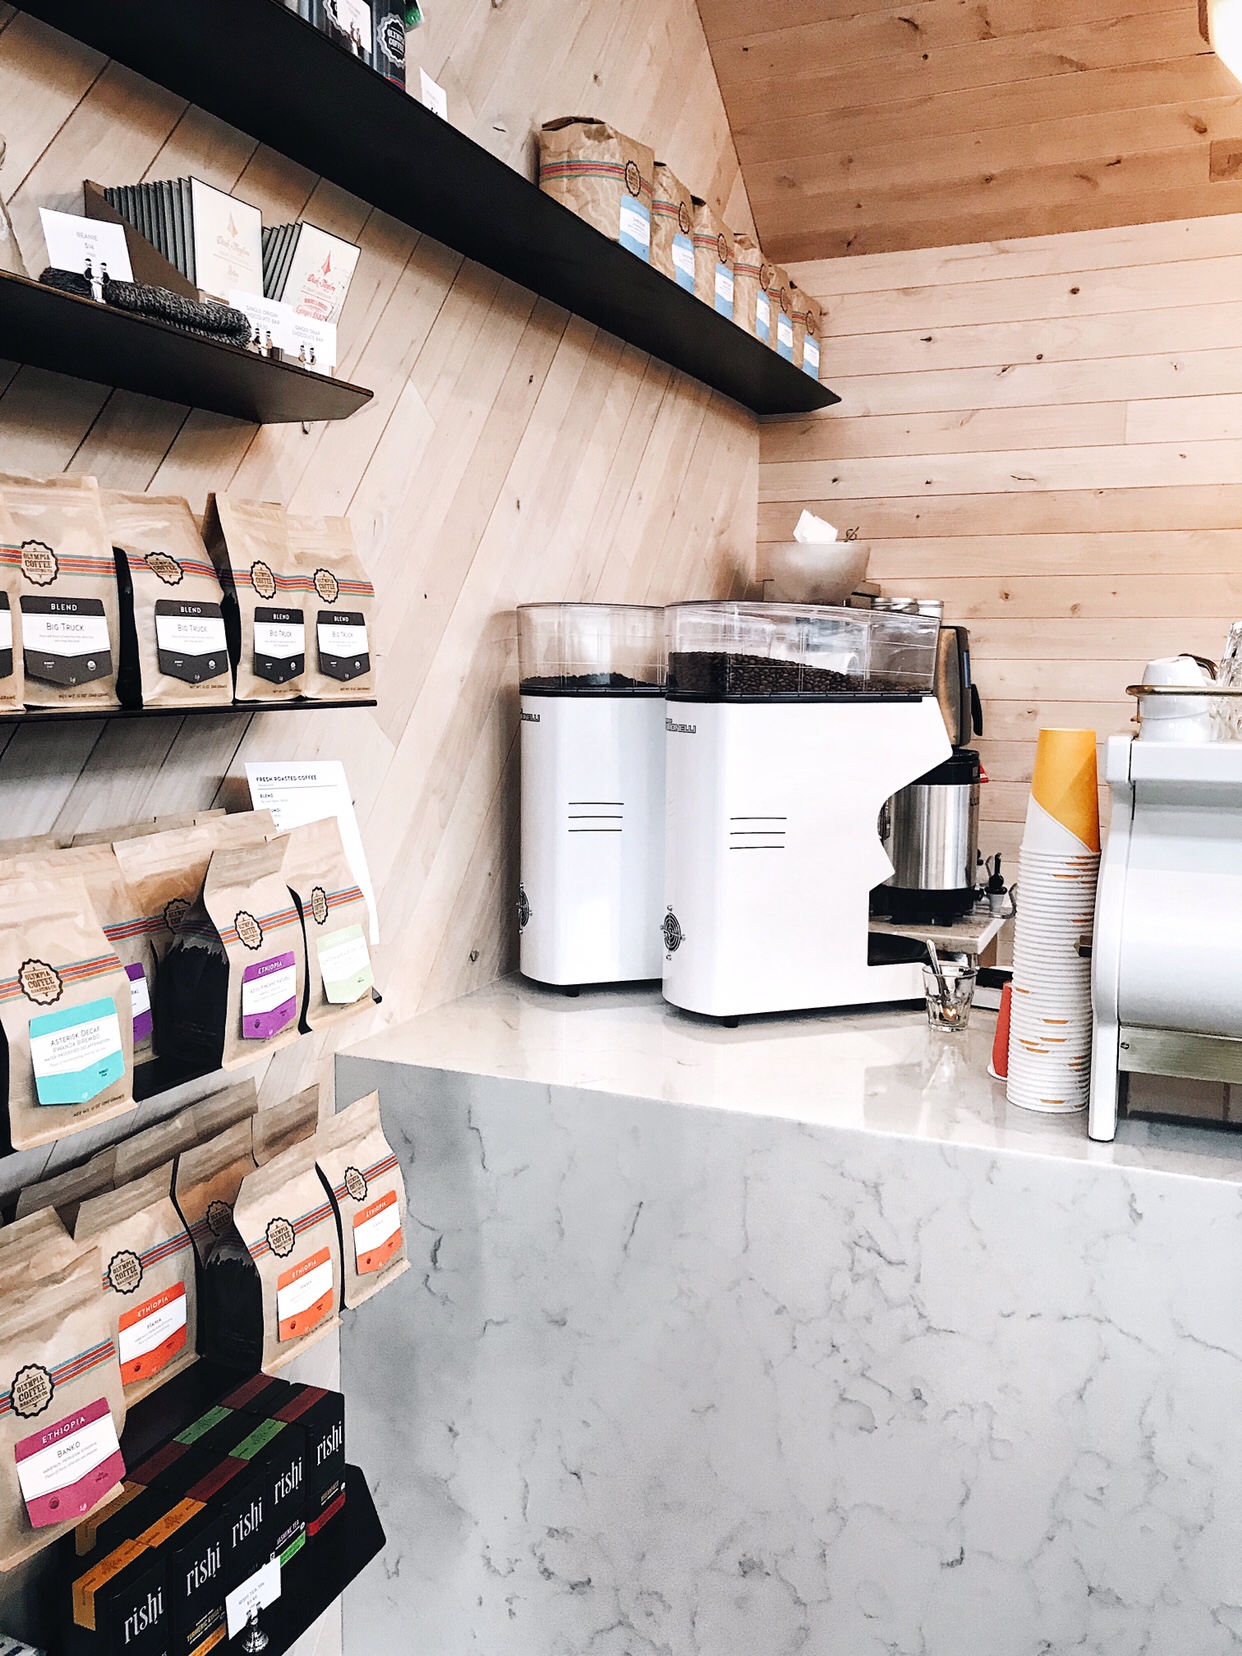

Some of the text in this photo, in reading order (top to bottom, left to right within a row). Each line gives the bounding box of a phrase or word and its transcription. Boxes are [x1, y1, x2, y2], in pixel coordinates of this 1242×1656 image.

[76, 231, 98, 241] BEANIE
[244, 311, 271, 323] CHOCOLATE
[246, 305, 278, 318] SINGLE ORIGIN
[292, 330, 315, 340] CHOCOLATE
[23, 552, 50, 560] OLYMPIA
[25, 560, 52, 569] COFFEE
[50, 603, 78, 611] BLEND
[180, 606, 202, 614] BLEND
[272, 613, 290, 621] BLEND
[46, 622, 85, 632] BIG TRUCK
[177, 624, 208, 633] BIG TRUCK
[257, 961, 283, 975] ETHIOPIA
[24, 971, 51, 981] OLYMPIA
[27, 977, 56, 990] COFFEE
[50, 1025, 101, 1047] ASTERISK DECAF
[52, 1033, 101, 1053] RWANDA BIREMBO
[365, 1201, 387, 1218] ETHIOPIA
[270, 1226, 289, 1239] OLYMPIA
[272, 1231, 291, 1246] COFFEE
[112, 1260, 135, 1274] OLYMPIA
[114, 1265, 138, 1281] COFFEE
[291, 1259, 318, 1278] ETHIOPIA
[137, 1296, 169, 1318] ETHIOPIA
[16, 1376, 45, 1393] OLYMPIA
[18, 1382, 47, 1402] COFFEE
[19, 1394, 41, 1408] ROASTING
[42, 1416, 86, 1444] ETHIOPIA
[56, 1441, 81, 1458] BANKO
[316, 1421, 343, 1466] rishi
[274, 1457, 303, 1505] rishi
[231, 1496, 263, 1548] rishi
[276, 1519, 300, 1546] JASMINE TEA
[186, 1541, 222, 1596] rishi
[124, 1586, 164, 1645] rishi
